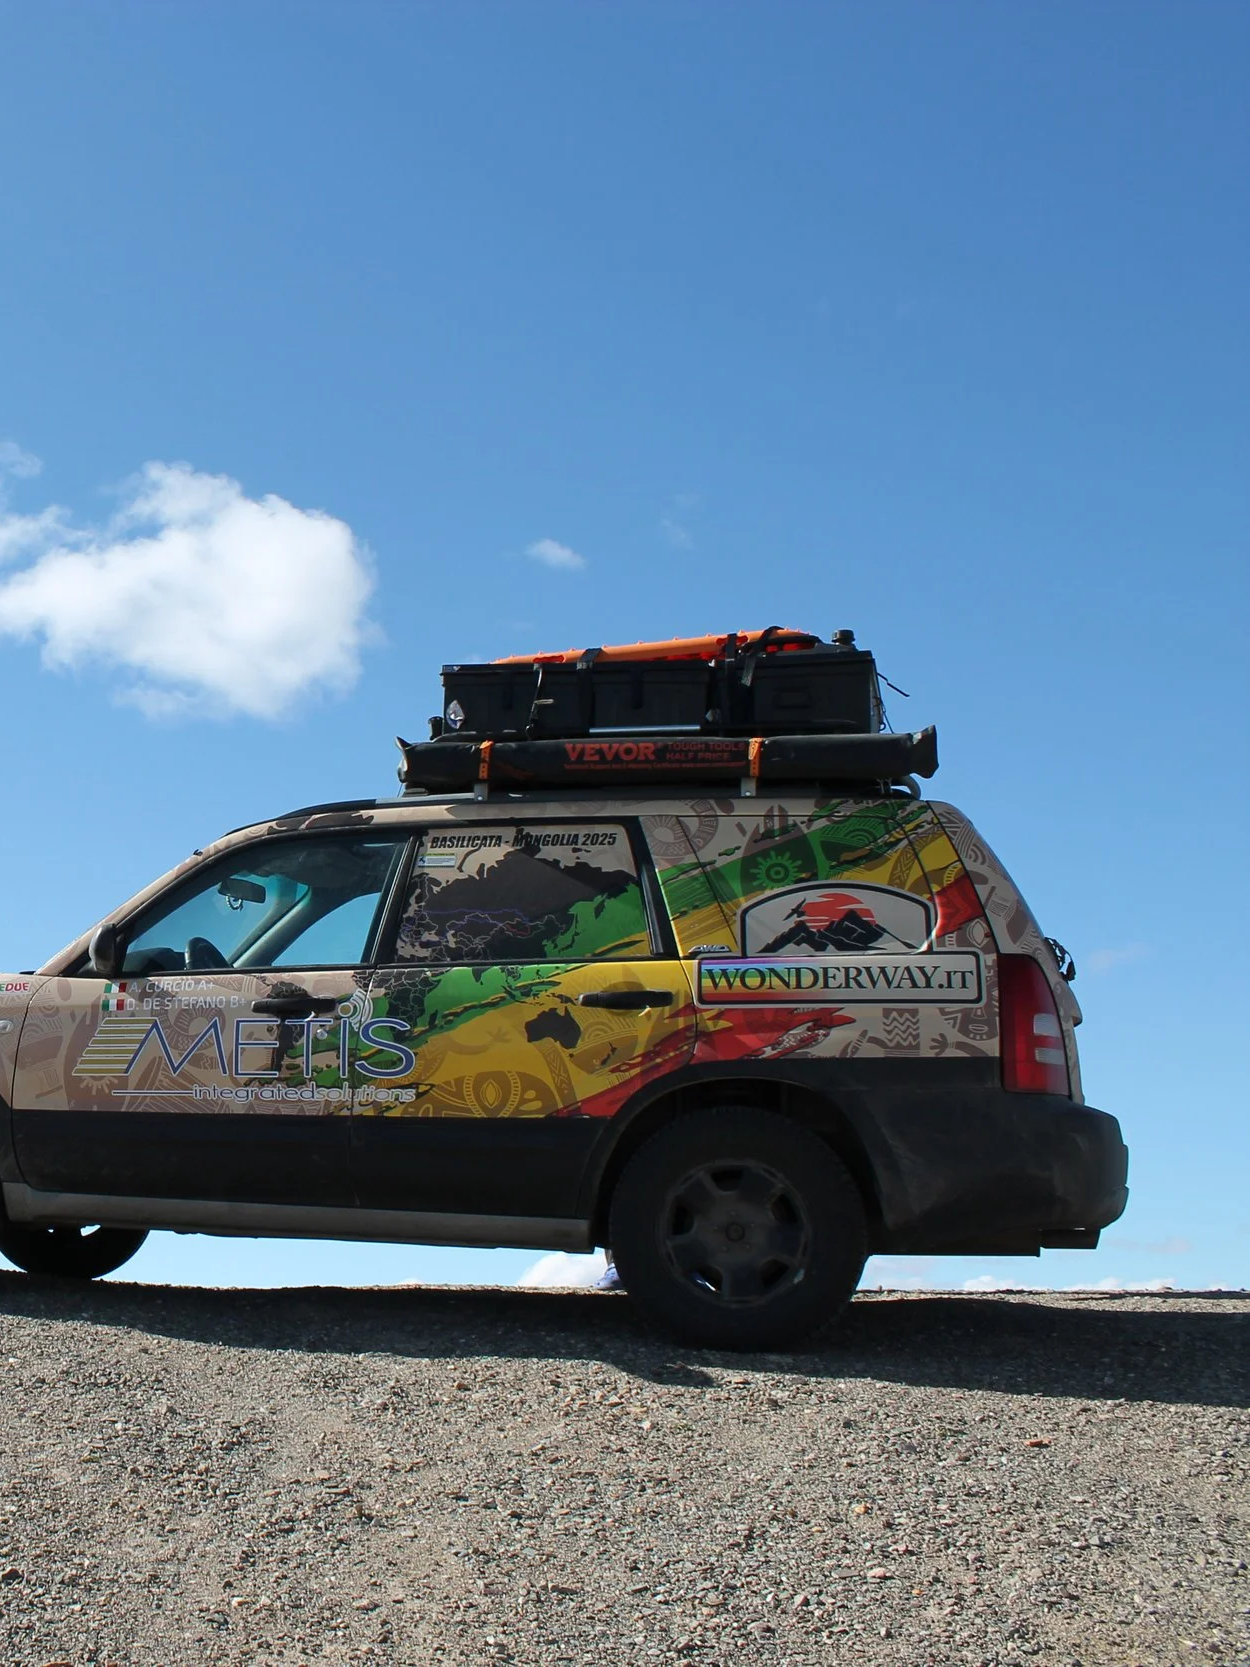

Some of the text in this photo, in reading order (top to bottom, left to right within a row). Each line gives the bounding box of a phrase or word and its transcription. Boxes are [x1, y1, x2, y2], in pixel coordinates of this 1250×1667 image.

[564, 742, 655, 761] VEVOR
[667, 742, 745, 751] TOUGH TOOLS
[429, 834, 503, 849] BASILICATA
[512, 832, 579, 848] MONGOLIA
[581, 832, 618, 846] 2025
[128, 980, 215, 993] A. CURCIO A+
[704, 965, 974, 992] WONDERWAY.IT
[125, 995, 247, 1011] D. DE STEFANO B+
